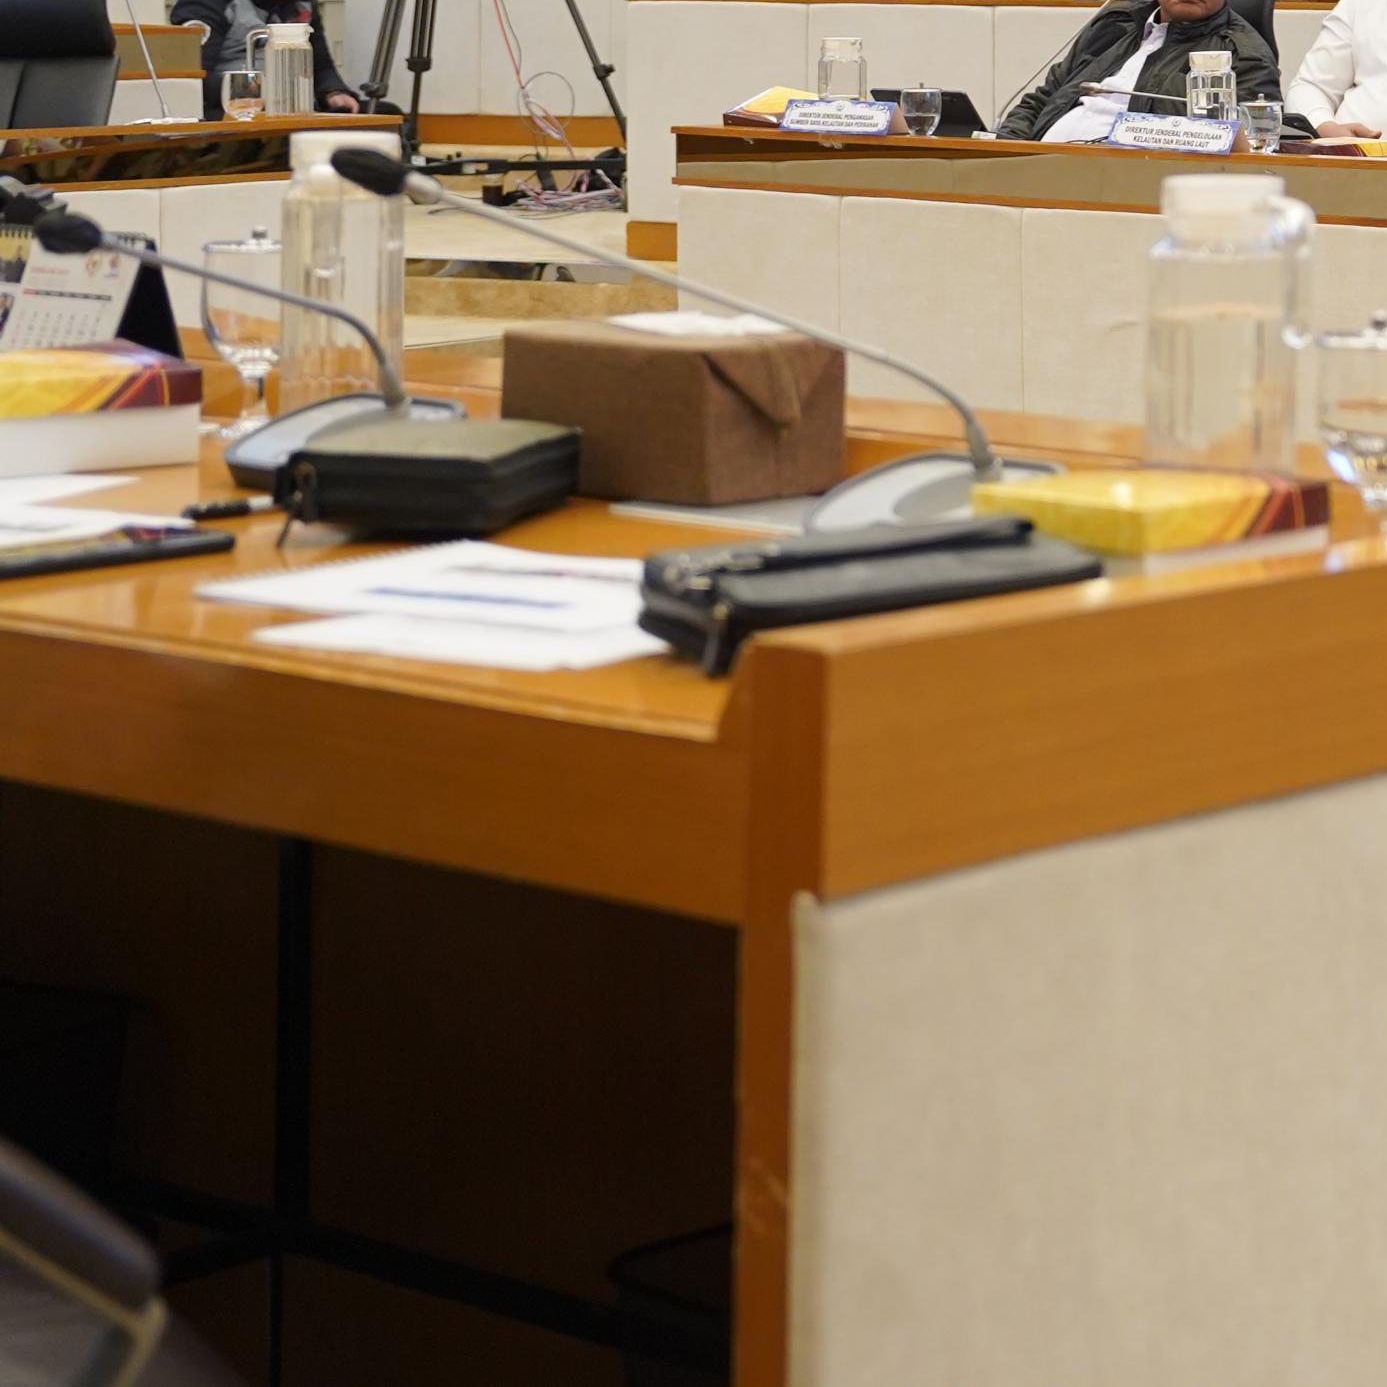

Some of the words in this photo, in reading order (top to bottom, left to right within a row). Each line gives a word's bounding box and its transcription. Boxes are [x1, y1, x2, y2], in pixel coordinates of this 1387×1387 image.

[1125, 126, 1154, 135] DIREKTUR
[1154, 128, 1181, 137] JENDERAL
[1183, 130, 1222, 140] PENGELOLAAN
[1133, 135, 1161, 145] KELAUTAN
[1175, 138, 1194, 147] RUANG
[1195, 140, 1210, 148] LAUT
